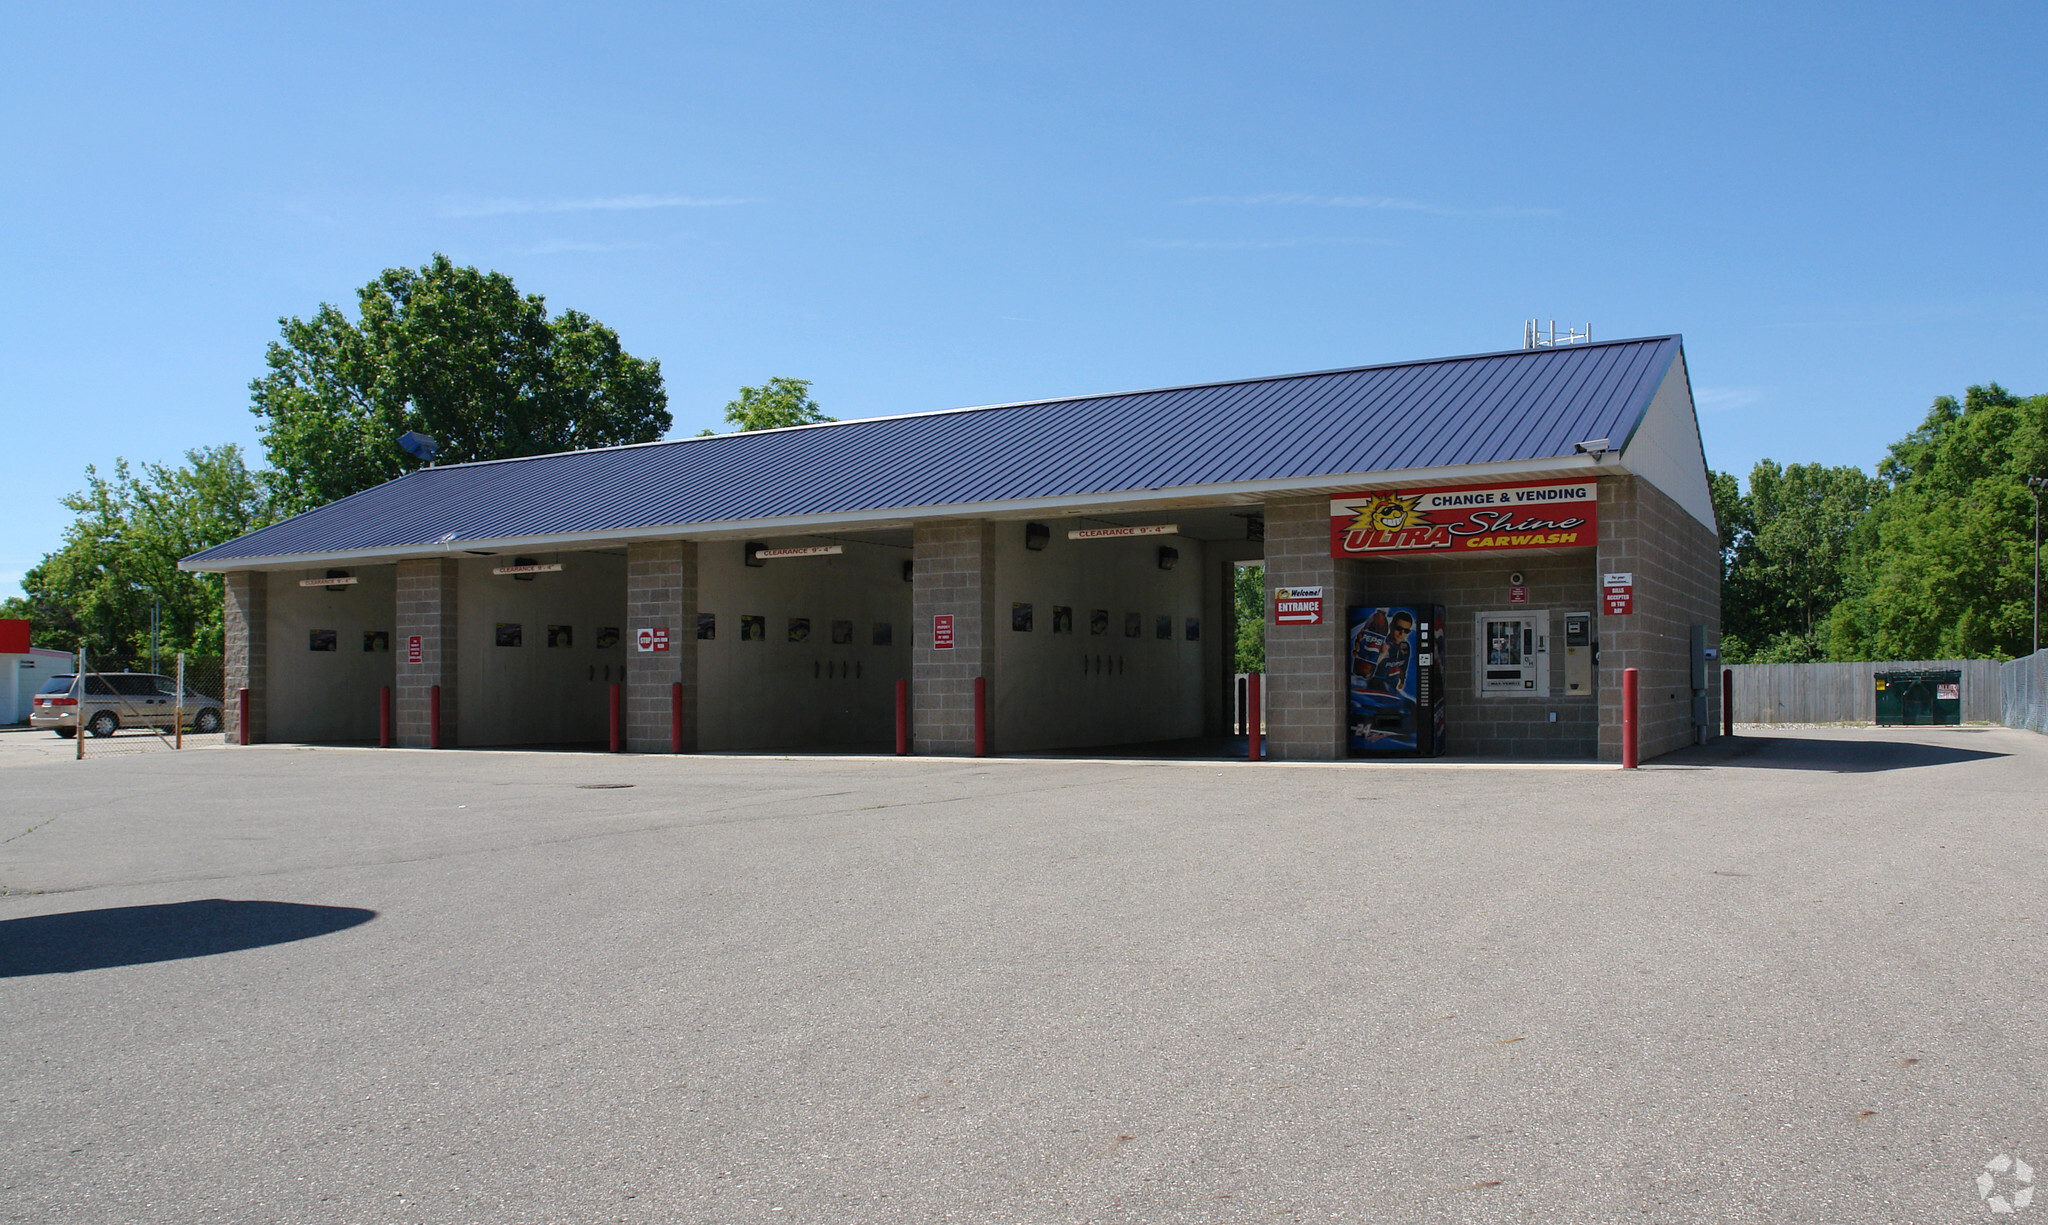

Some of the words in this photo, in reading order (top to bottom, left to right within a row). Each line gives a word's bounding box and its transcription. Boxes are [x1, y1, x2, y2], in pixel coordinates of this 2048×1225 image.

[1431, 493, 1494, 507] CHANGE
[1500, 492, 1511, 503] &
[1516, 487, 1587, 502] VENDING
[1079, 528, 1135, 537] CLEARANCE
[1344, 523, 1452, 551] ULTRA
[1449, 511, 1585, 535] Shine
[1466, 532, 1578, 548] CARWASH
[763, 548, 808, 556] CLEARANCE
[1291, 588, 1321, 597] Welcome!
[1278, 601, 1320, 612] ENTRANCE
[640, 636, 651, 644] STOP
[1362, 634, 1384, 646] PEPSI
